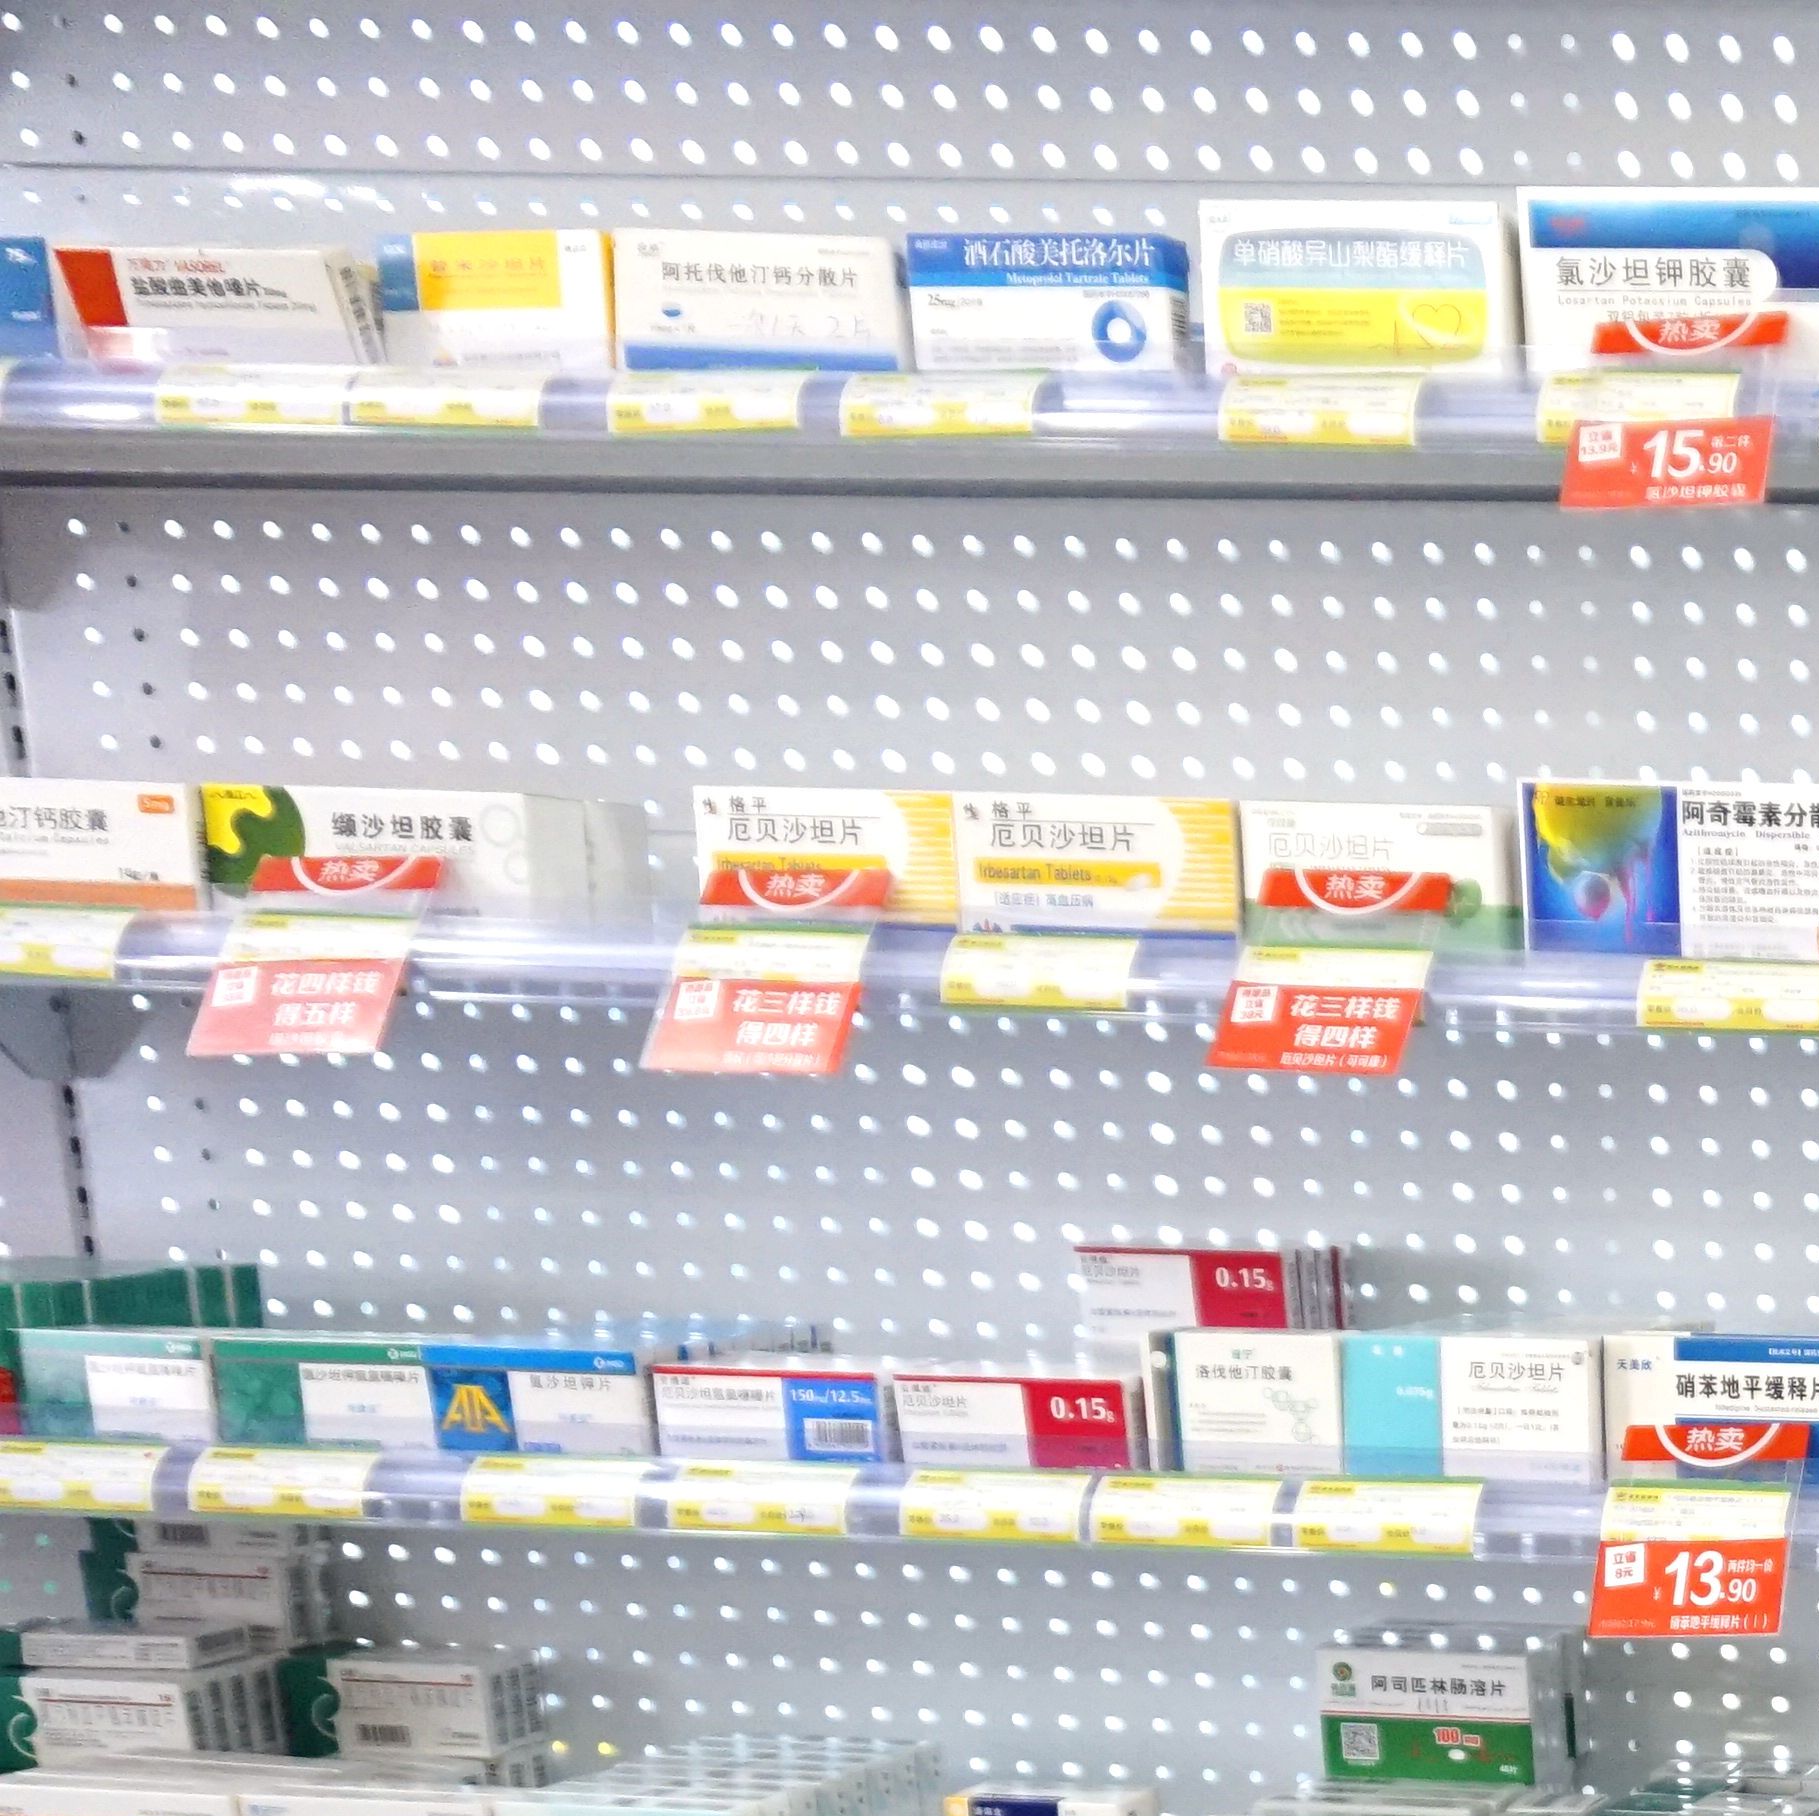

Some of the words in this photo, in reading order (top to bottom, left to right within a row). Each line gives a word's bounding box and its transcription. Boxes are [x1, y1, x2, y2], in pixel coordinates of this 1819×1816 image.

[964, 237, 1155, 268] 酒石酸美托洛尔片
[1232, 240, 1470, 271] 单硝酸异山梨酯缓释片
[661, 262, 858, 287] 阿托伐他汀钙分散片
[1556, 255, 1752, 289] 氯沙坦钾胶囊
[1658, 319, 1720, 342] 热卖
[331, 812, 475, 843] 缬沙坦胶囊
[727, 817, 864, 847] 厄贝沙坦片
[989, 823, 1136, 852] 厄贝沙坦片
[319, 859, 381, 884] 热卖
[764, 874, 826, 897] 热卖
[1323, 874, 1386, 901] 热卖
[273, 1003, 356, 1029] 得五样
[731, 991, 841, 1017] 花三样钱
[1288, 995, 1400, 1020] 花三样钱
[736, 1021, 817, 1047] 得四样
[1294, 1024, 1378, 1051] 得四样
[1194, 1361, 1294, 1384] 洛伐他汀胶囊
[1468, 1359, 1566, 1384] 厄贝沙坦片
[1049, 1396, 1116, 1425] 0.15g
[1684, 1427, 1747, 1454] 热卖
[1370, 1673, 1507, 1699] 阿司匹林肠溶片
